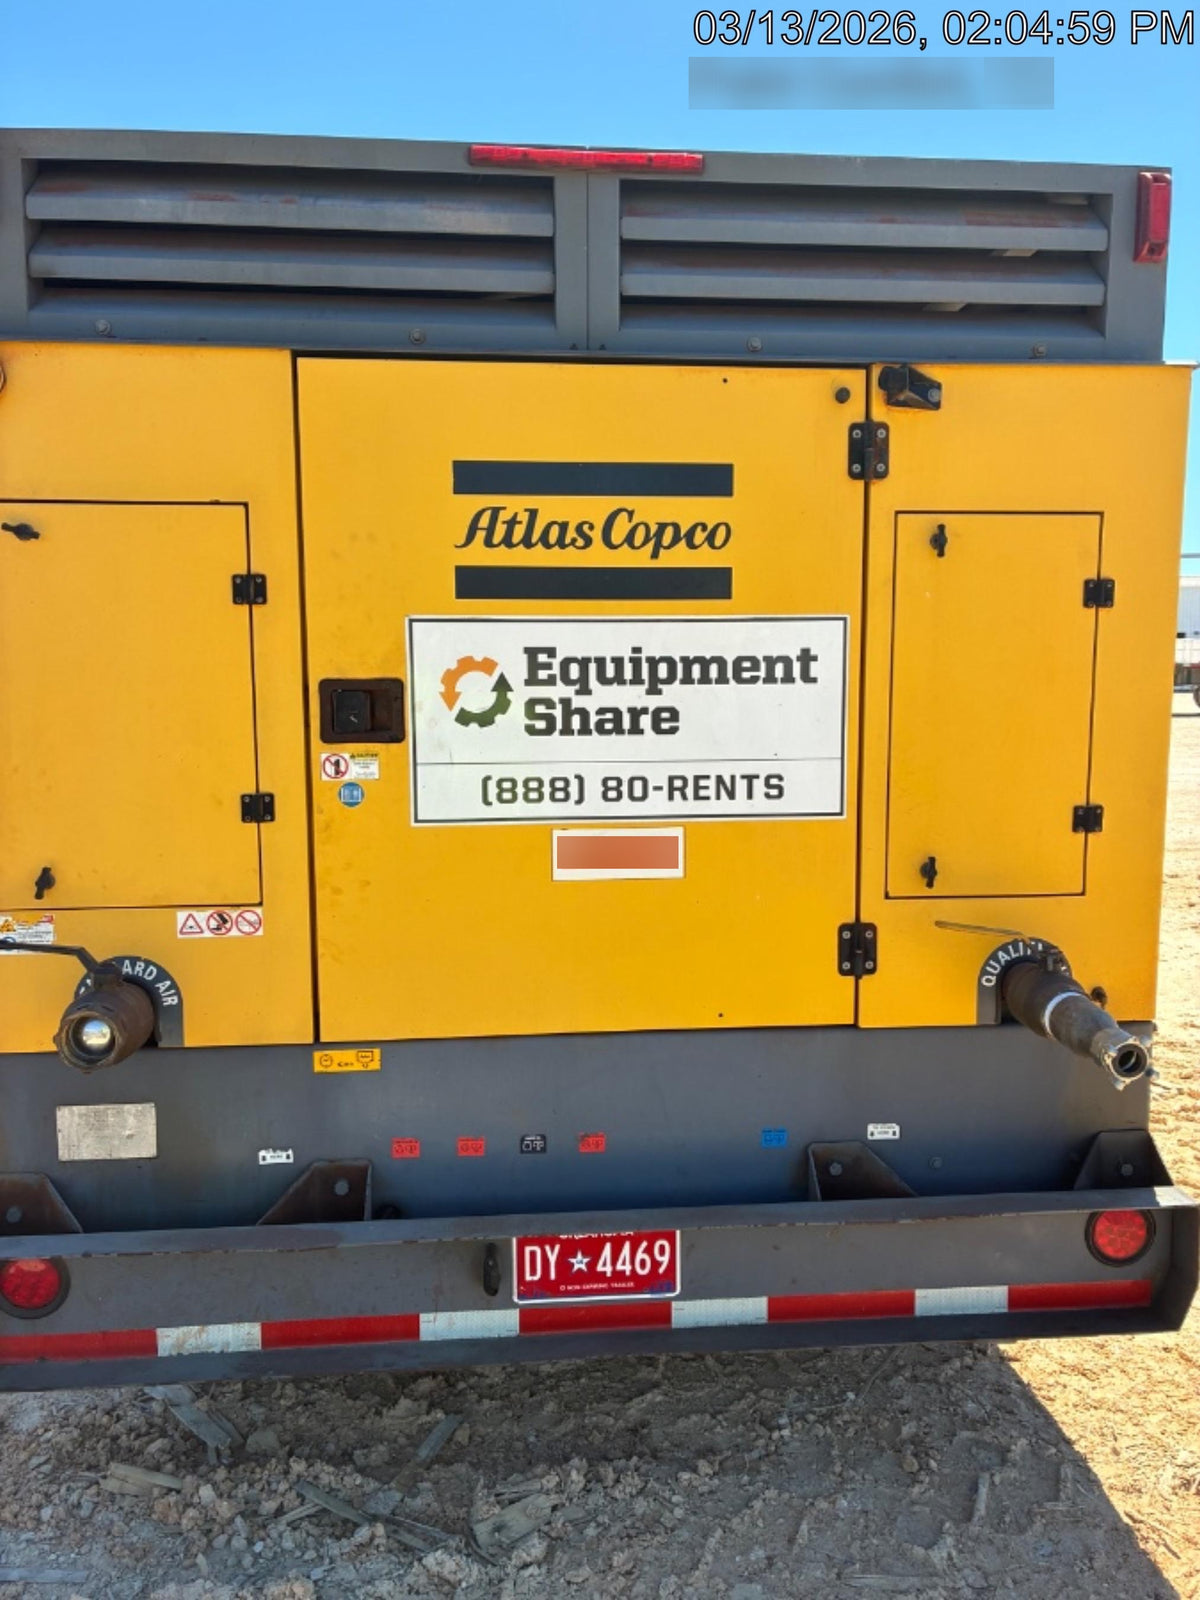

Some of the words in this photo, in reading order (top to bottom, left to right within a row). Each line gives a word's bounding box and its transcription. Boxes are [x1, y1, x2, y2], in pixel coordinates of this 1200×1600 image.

[454, 506, 595, 550] Atlas
[601, 507, 732, 560] Copco
[523, 646, 818, 695] Equipment
[524, 697, 680, 736] Share
[481, 774, 585, 806] (888)
[601, 774, 786, 801] 80-RENTS
[981, 941, 1046, 987] QUALI
[155, 980, 179, 1006] AIR
[524, 1244, 560, 1281] DY
[596, 1239, 671, 1278] 4469
